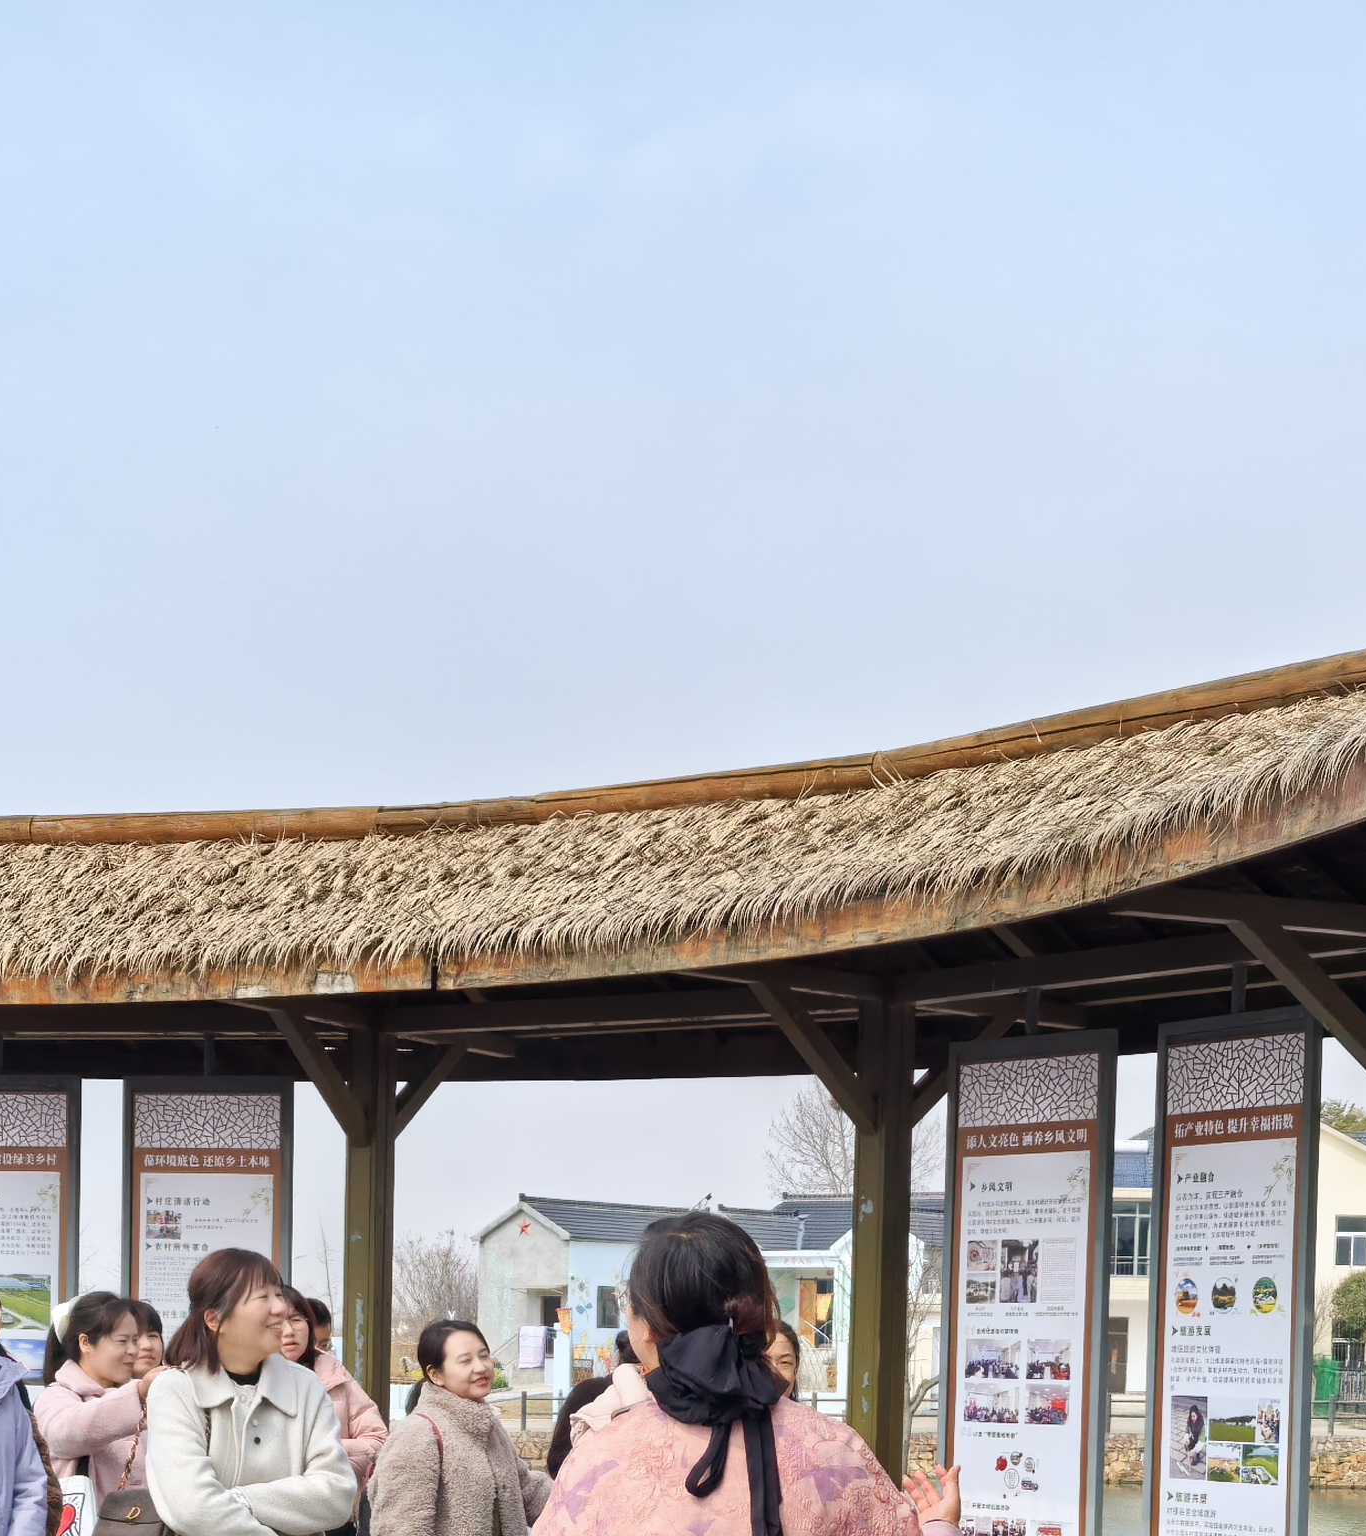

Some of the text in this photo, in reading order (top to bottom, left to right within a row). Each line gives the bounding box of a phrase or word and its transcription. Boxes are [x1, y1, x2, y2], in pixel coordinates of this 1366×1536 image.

[1174, 1113, 1294, 1139] 拓产业特色 提升幸福指数
[966, 1128, 1088, 1149] 添人文亮色 涵养乡风文明
[202, 1155, 270, 1169] 还原乡土本味
[1184, 1171, 1215, 1183] 产业融合
[981, 1181, 1013, 1193] 乡风文明
